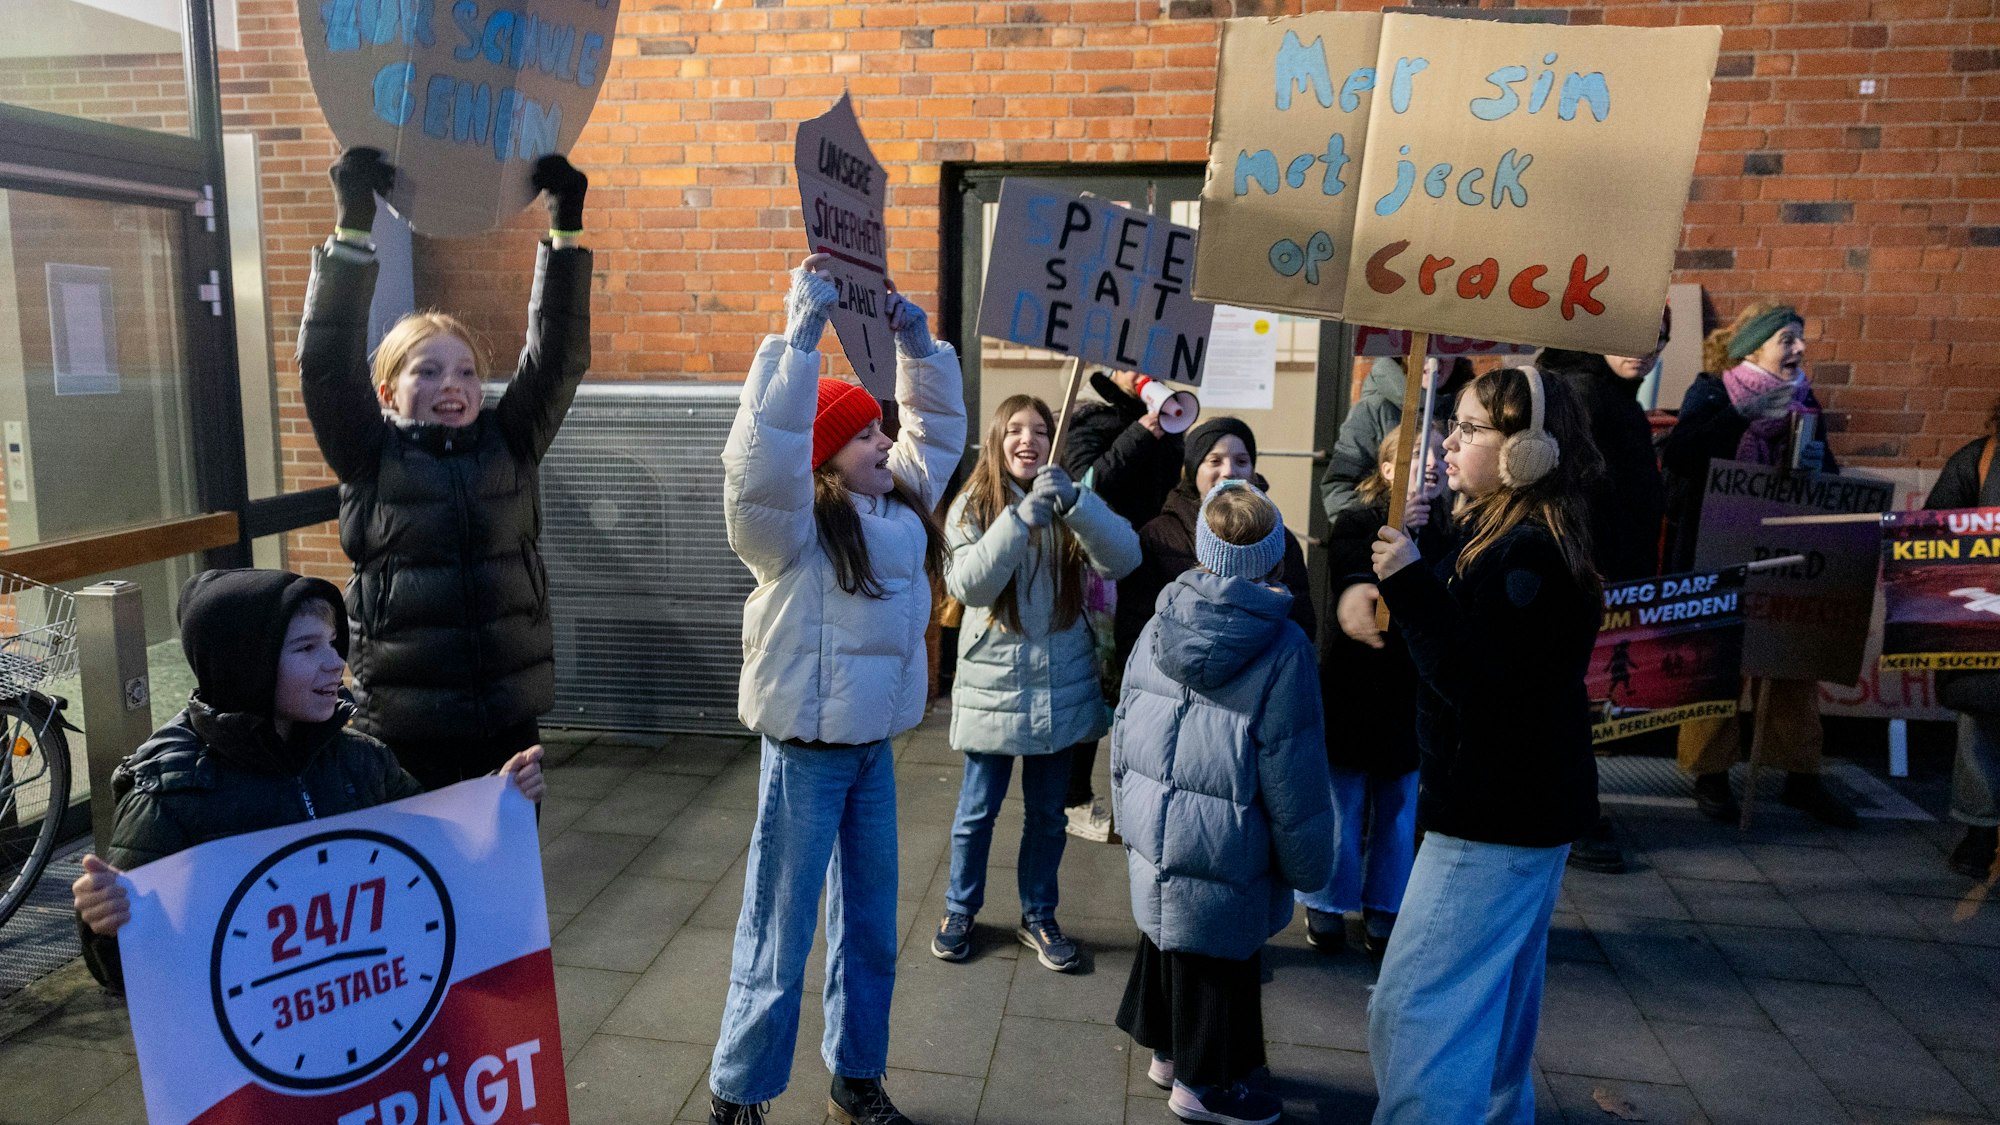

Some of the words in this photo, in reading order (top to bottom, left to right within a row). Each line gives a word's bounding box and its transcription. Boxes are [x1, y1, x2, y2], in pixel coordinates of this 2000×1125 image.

[452, 0, 603, 88] SCHULE
[1275, 29, 1430, 113] Mer
[1470, 52, 1611, 122] sin
[372, 62, 562, 164] GEHEN
[818, 136, 872, 196] UNSERE
[1234, 133, 1350, 197] net
[1374, 145, 1534, 217] jeck
[1268, 231, 1335, 286] op
[833, 273, 878, 319] ZÄHLT
[1008, 289, 1204, 381] DEALEN
[1893, 538, 1960, 560] KEIN
[1638, 591, 1739, 626] WERDEN!
[1661, 573, 1720, 600] DARF
[267, 876, 386, 963] 24/7
